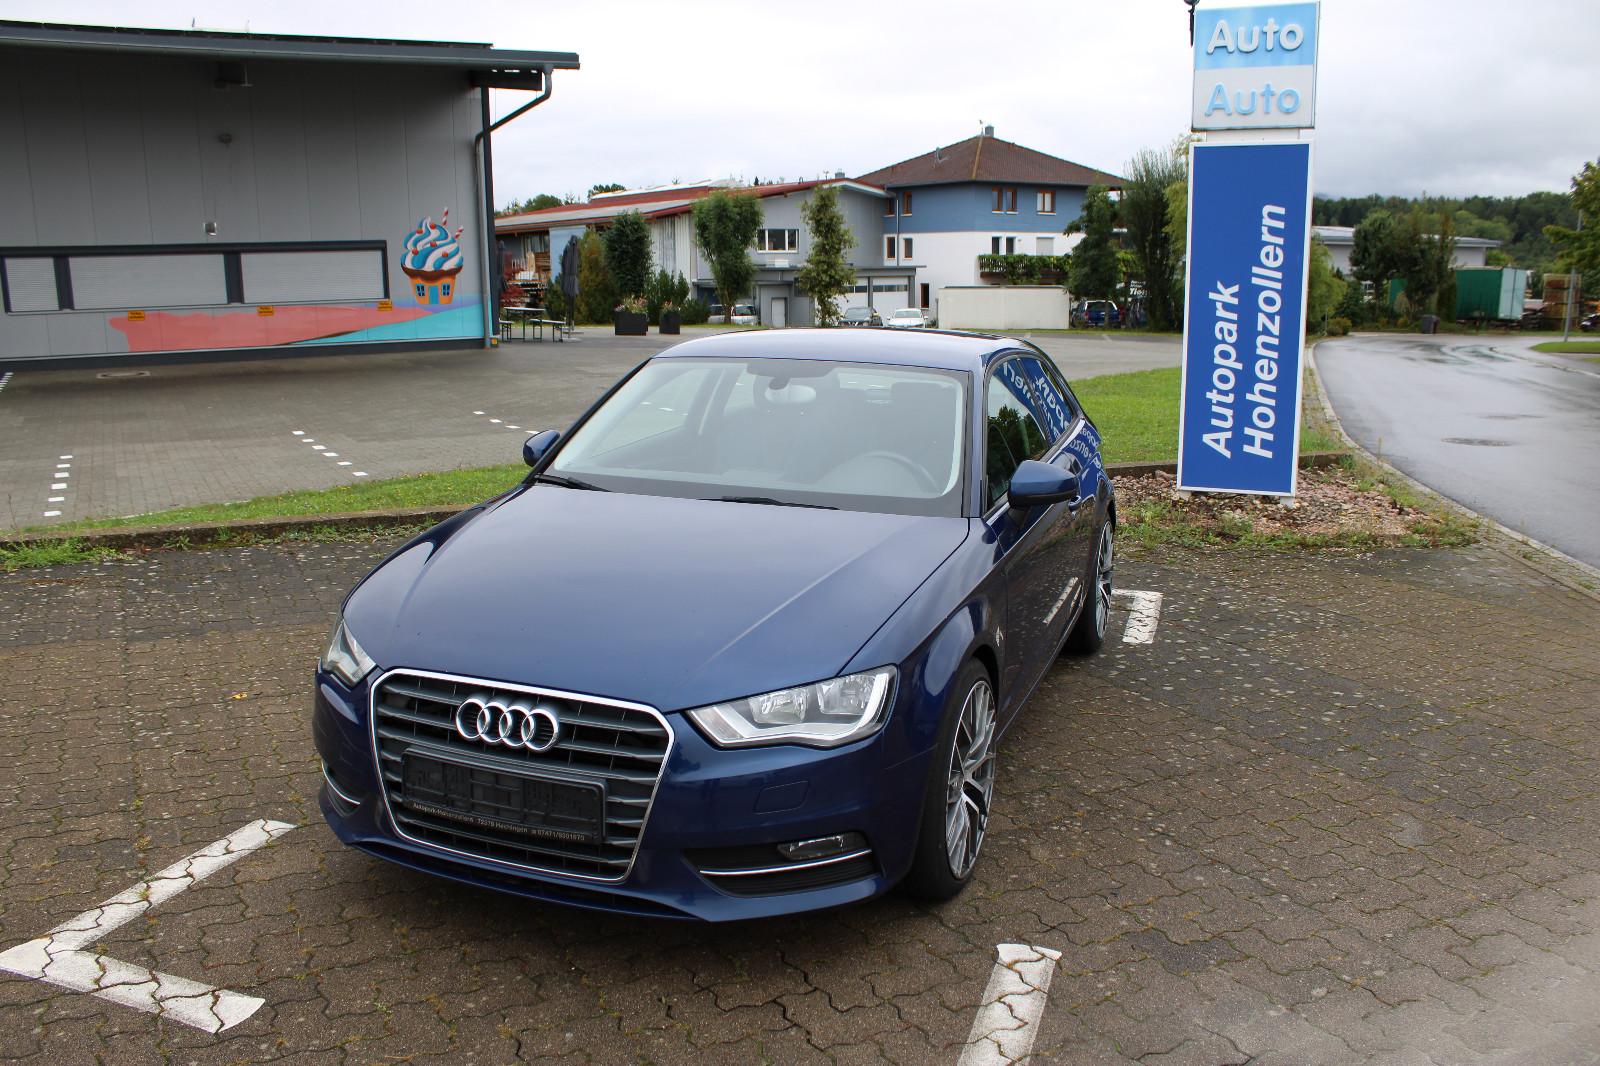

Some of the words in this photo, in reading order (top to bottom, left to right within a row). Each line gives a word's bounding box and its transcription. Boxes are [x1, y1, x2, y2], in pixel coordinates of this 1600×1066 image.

[1206, 18, 1304, 55] Auto
[1204, 82, 1300, 116] Auto
[1202, 280, 1243, 459] Autopark
[1243, 204, 1286, 459] Hohenzollern
